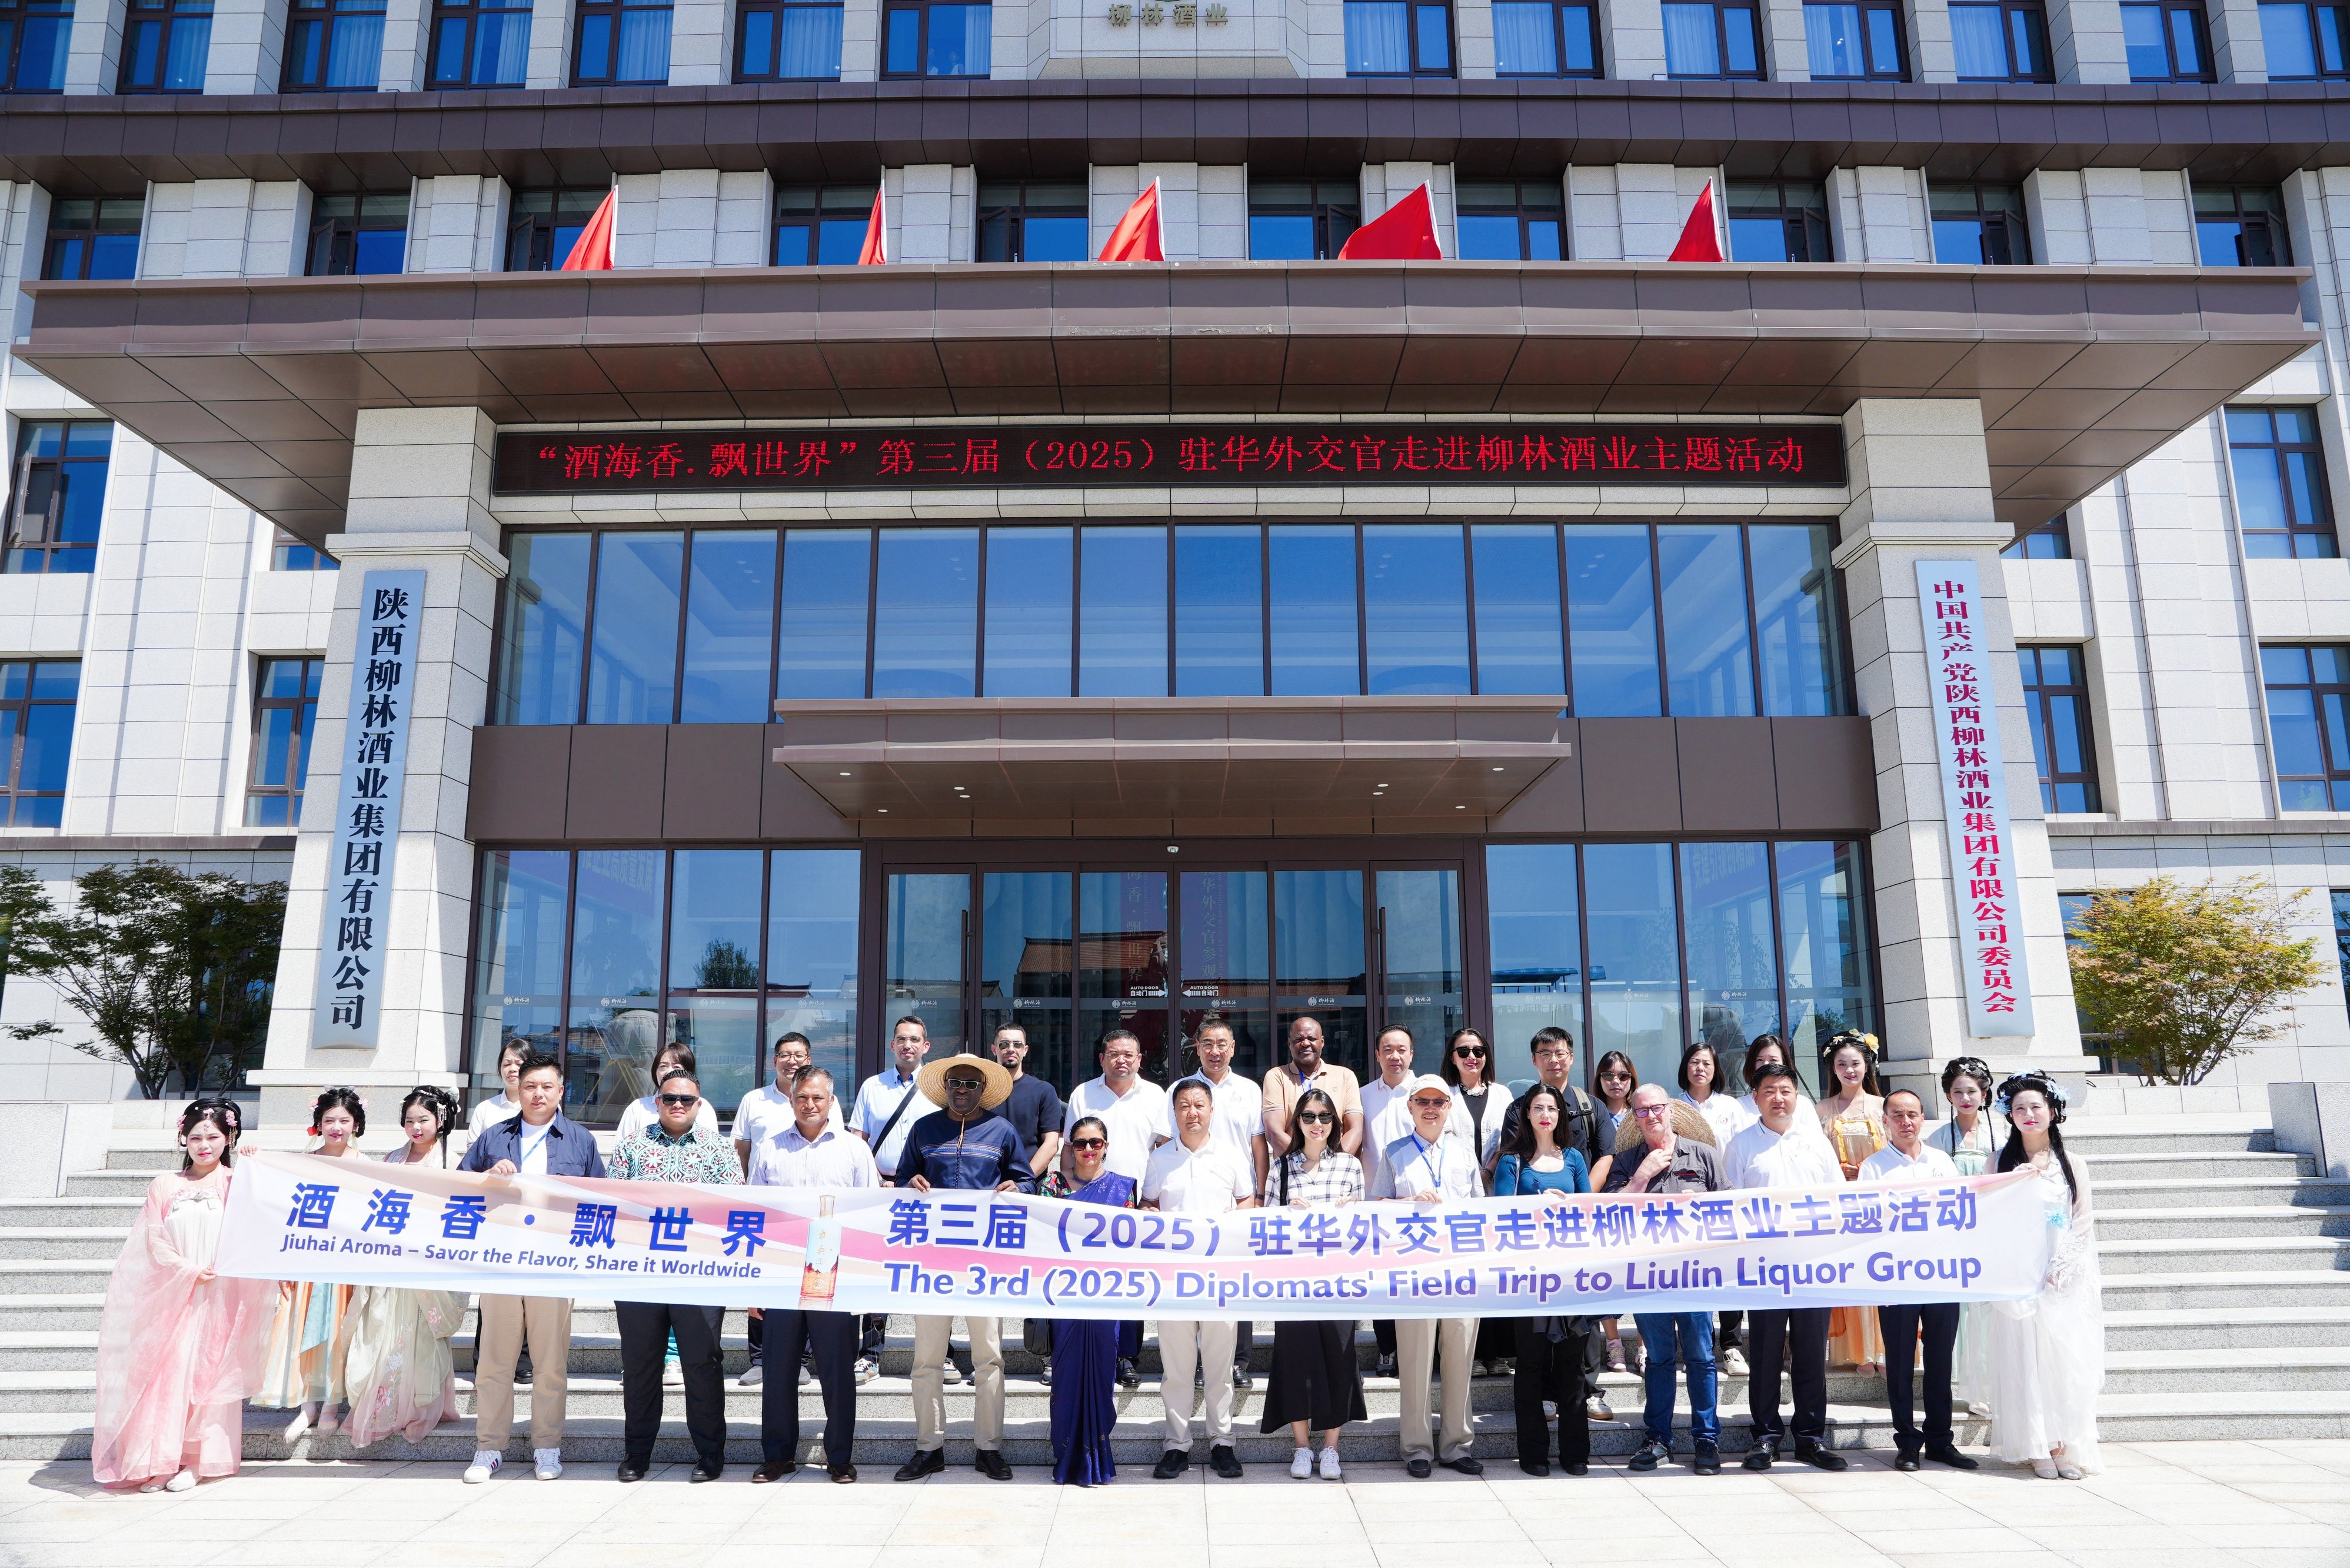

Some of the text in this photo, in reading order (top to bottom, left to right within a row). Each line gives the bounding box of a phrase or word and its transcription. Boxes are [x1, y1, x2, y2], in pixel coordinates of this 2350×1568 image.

[1109, 3, 1229, 25] 柳林酒业
[331, 587, 410, 1030] 陕西柳林酒业集团有限公司
[1933, 580, 2018, 1013] 中国共产党陕西柳林酒业集团有限公司委员会
[281, 1233, 335, 1251] Jiuhai
[339, 1239, 402, 1256] Aroma
[425, 1244, 478, 1261] Savor
[482, 1248, 512, 1263] the
[517, 1250, 577, 1270] Flavor,
[584, 1254, 638, 1271] Share
[644, 1259, 657, 1272] it
[661, 1260, 761, 1279] Worldwide
[286, 1182, 767, 1258] 酒海香·飘世界
[886, 1184, 1978, 1257] 第三届（2025）驻华外交官走进柳林酒业主题活动
[884, 1252, 1982, 1307] The 3rd (2025) Diplomats' Field Trip to Liulin Liquor Group
